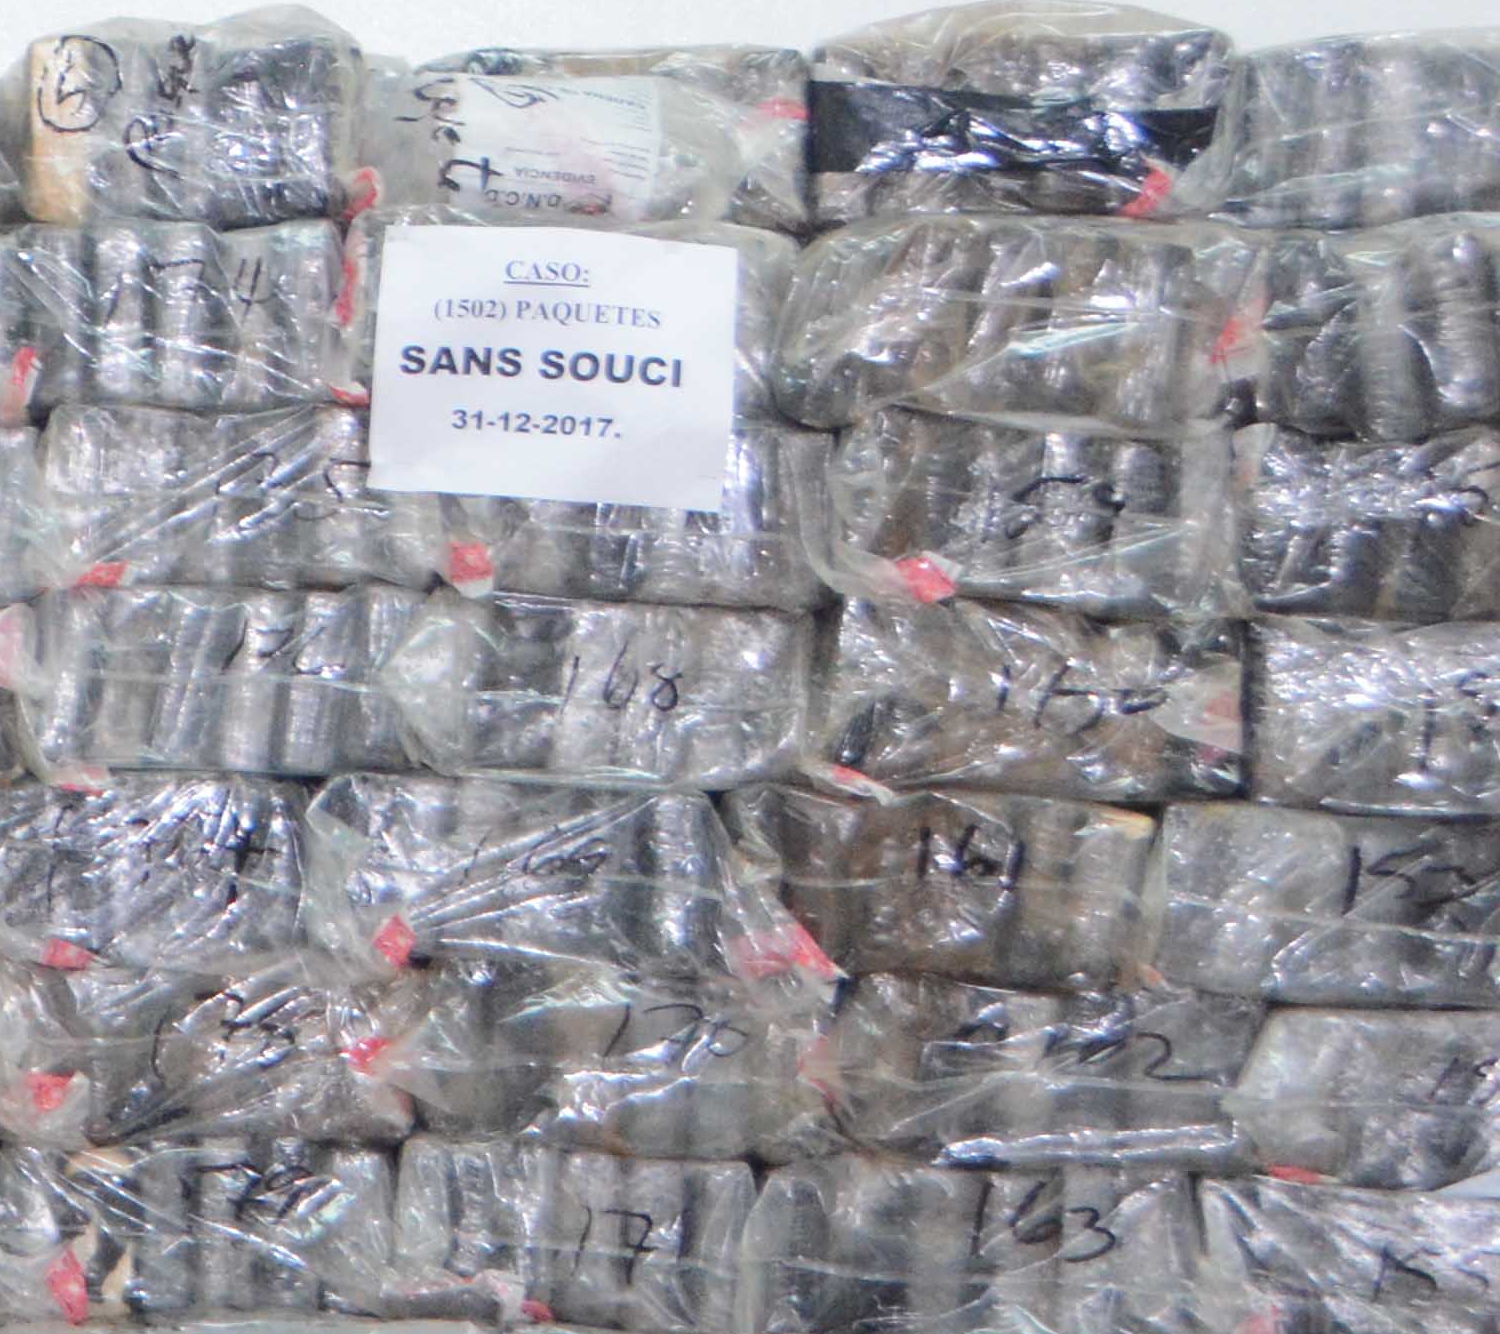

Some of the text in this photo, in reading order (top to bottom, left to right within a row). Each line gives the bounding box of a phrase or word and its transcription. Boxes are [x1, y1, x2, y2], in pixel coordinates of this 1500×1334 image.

[515, 166, 597, 184] EVIDENCIA
[504, 259, 590, 284] CASO:
[433, 298, 664, 330] (1502) PAQUETES
[400, 344, 683, 389] SANS SOUCI
[450, 408, 623, 440] 31-12-2017.
